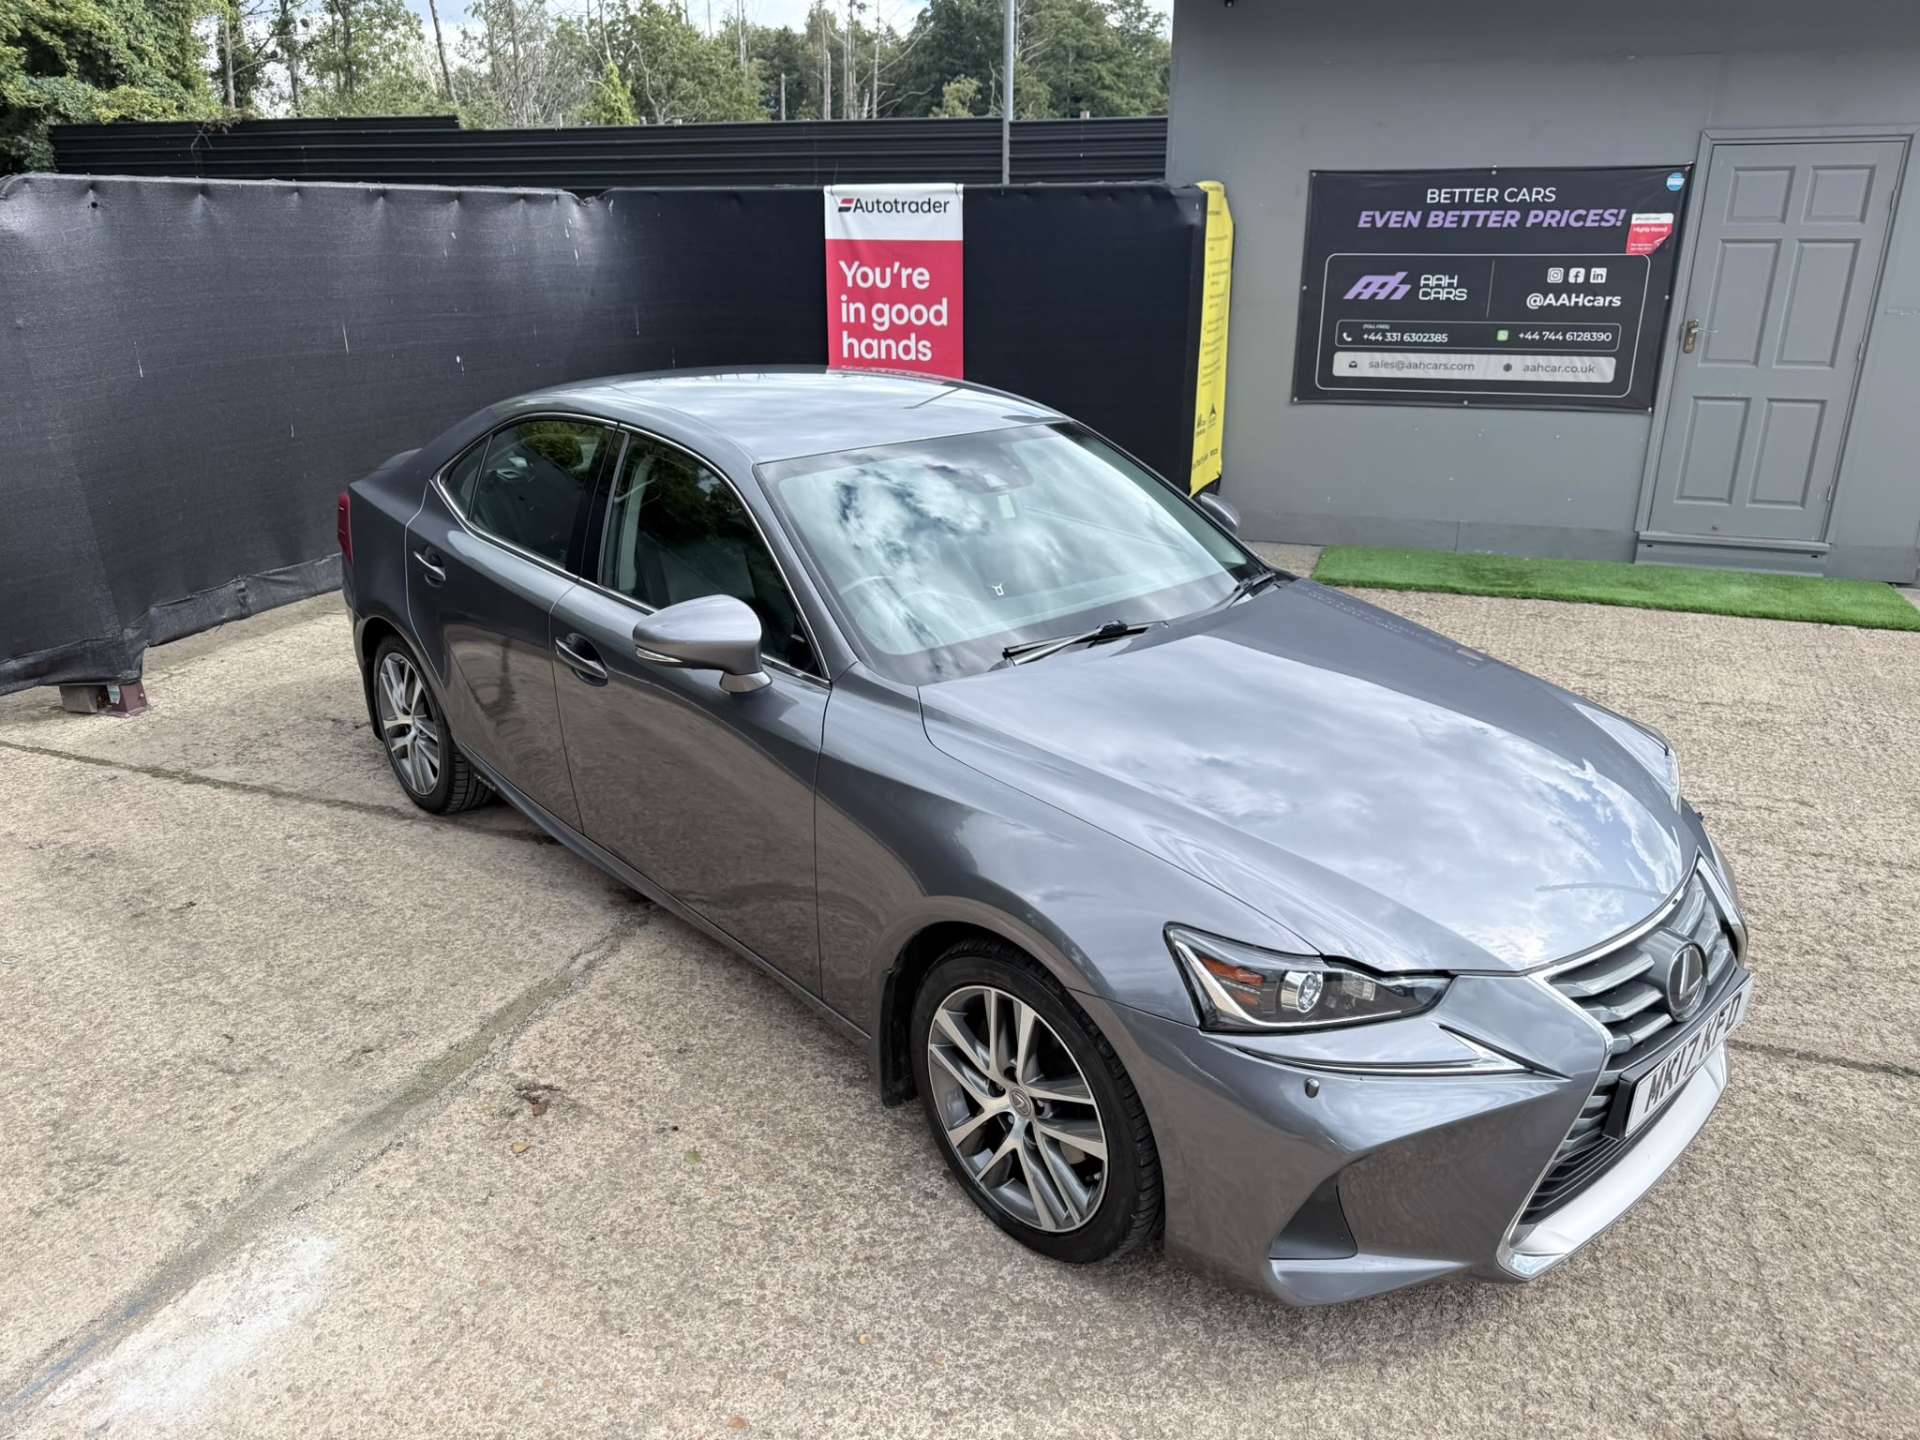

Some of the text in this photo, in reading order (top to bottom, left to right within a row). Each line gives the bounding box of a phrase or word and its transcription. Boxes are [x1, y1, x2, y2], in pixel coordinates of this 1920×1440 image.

[1426, 187, 1557, 203] BETTER CARS
[852, 198, 950, 214] Autotrader
[1357, 208, 1626, 228] EVEN BETTER PRICES!
[838, 260, 930, 290] You're
[1420, 274, 1459, 287] AAH
[1418, 287, 1468, 301] CARS
[1526, 293, 1622, 310] @AAHcars
[840, 294, 948, 332] in good
[1363, 332, 1383, 342] +44
[1518, 331, 1540, 341] +44
[1542, 331, 1563, 341] 744
[841, 331, 933, 361] hands
[1368, 359, 1476, 372] sales@aahcars.com
[1522, 362, 1596, 374] aahcar.co.uk
